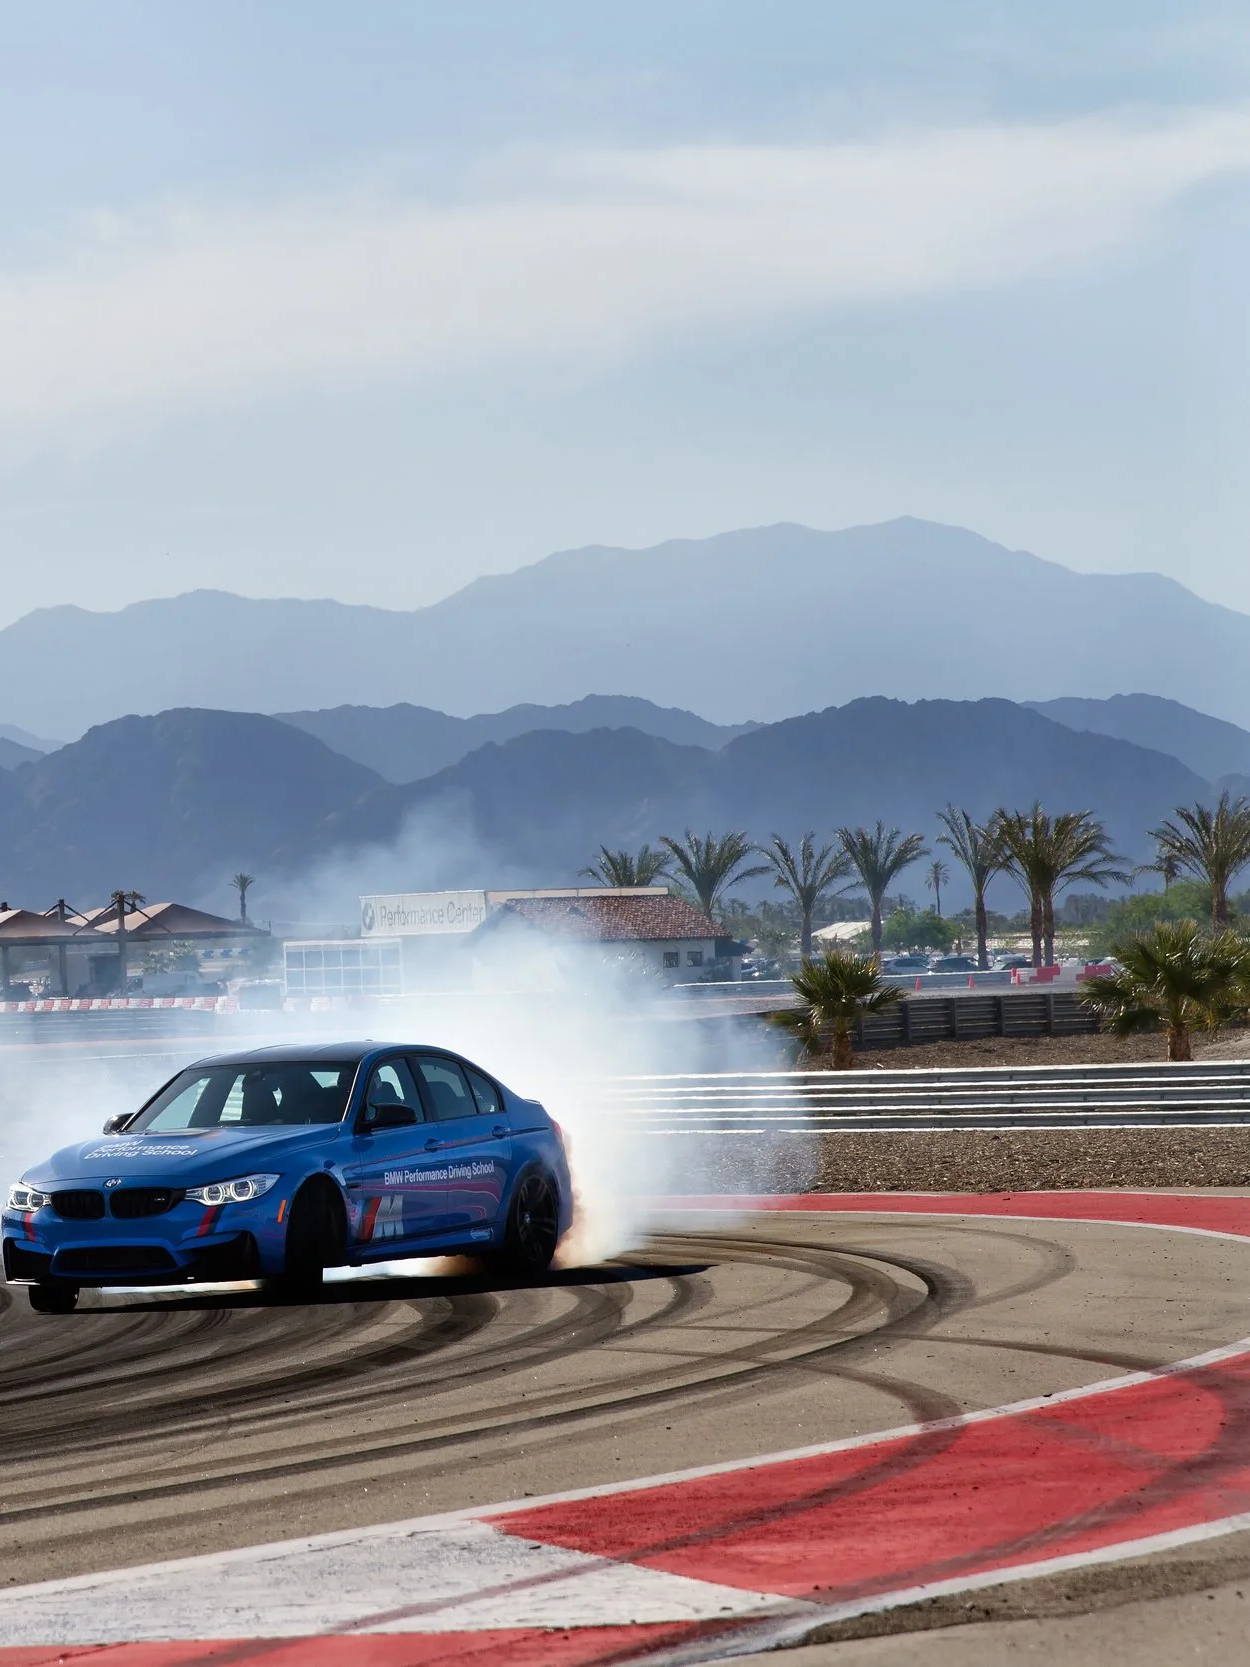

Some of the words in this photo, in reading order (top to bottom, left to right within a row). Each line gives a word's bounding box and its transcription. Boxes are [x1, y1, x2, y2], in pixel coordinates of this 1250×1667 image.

[379, 904, 444, 926] Performance
[447, 901, 484, 924] Center
[84, 1150, 139, 1159] Driving
[384, 1170, 403, 1185] BMW
[404, 1169, 448, 1183] Performance
[448, 1165, 471, 1179] Driving
[472, 1160, 495, 1175] School
